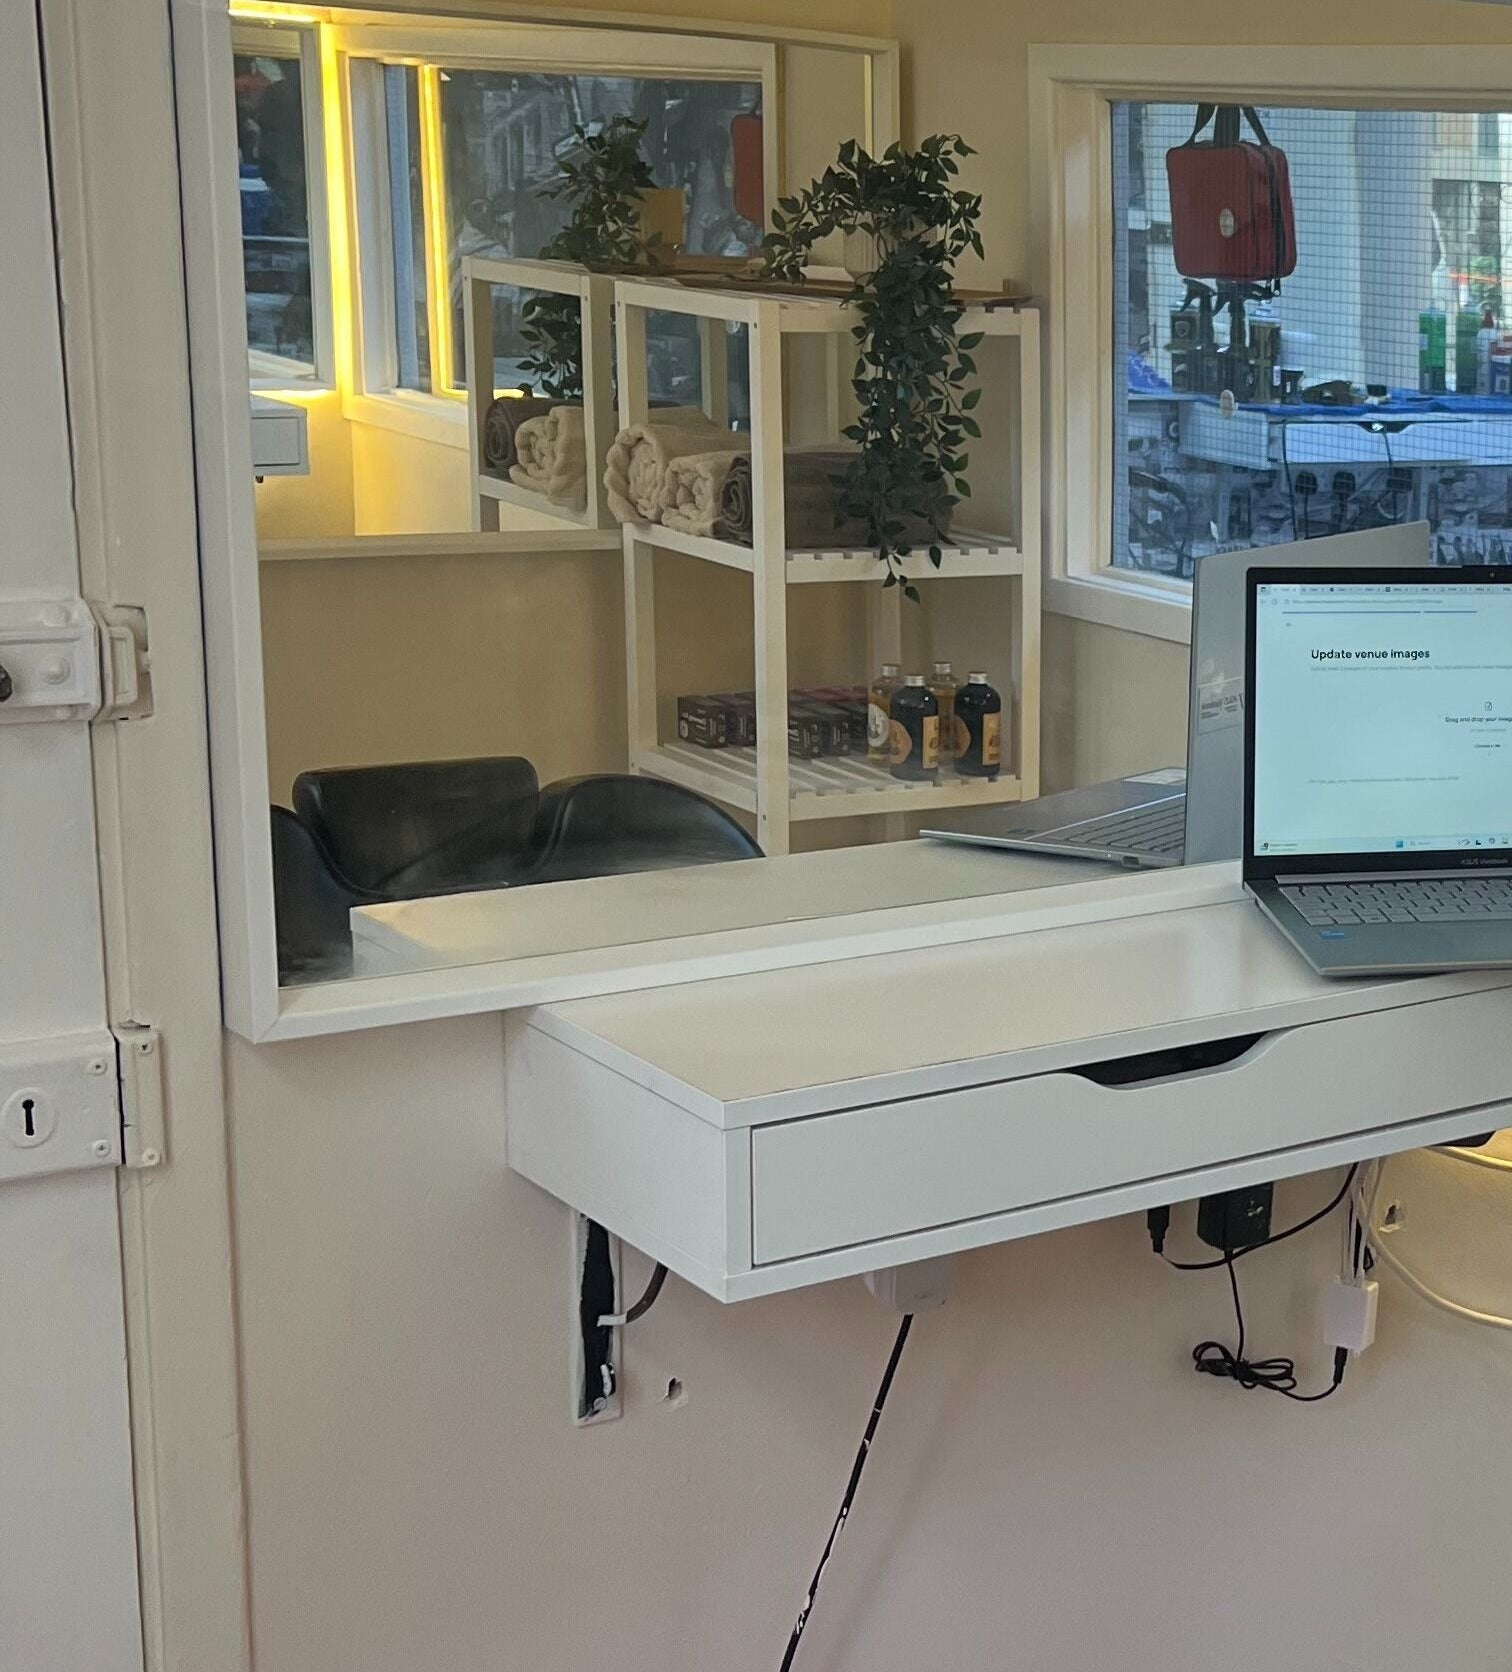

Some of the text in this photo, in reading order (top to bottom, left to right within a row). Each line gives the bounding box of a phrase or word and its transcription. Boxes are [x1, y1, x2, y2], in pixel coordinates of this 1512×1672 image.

[1311, 648, 1430, 661] Update venue images
